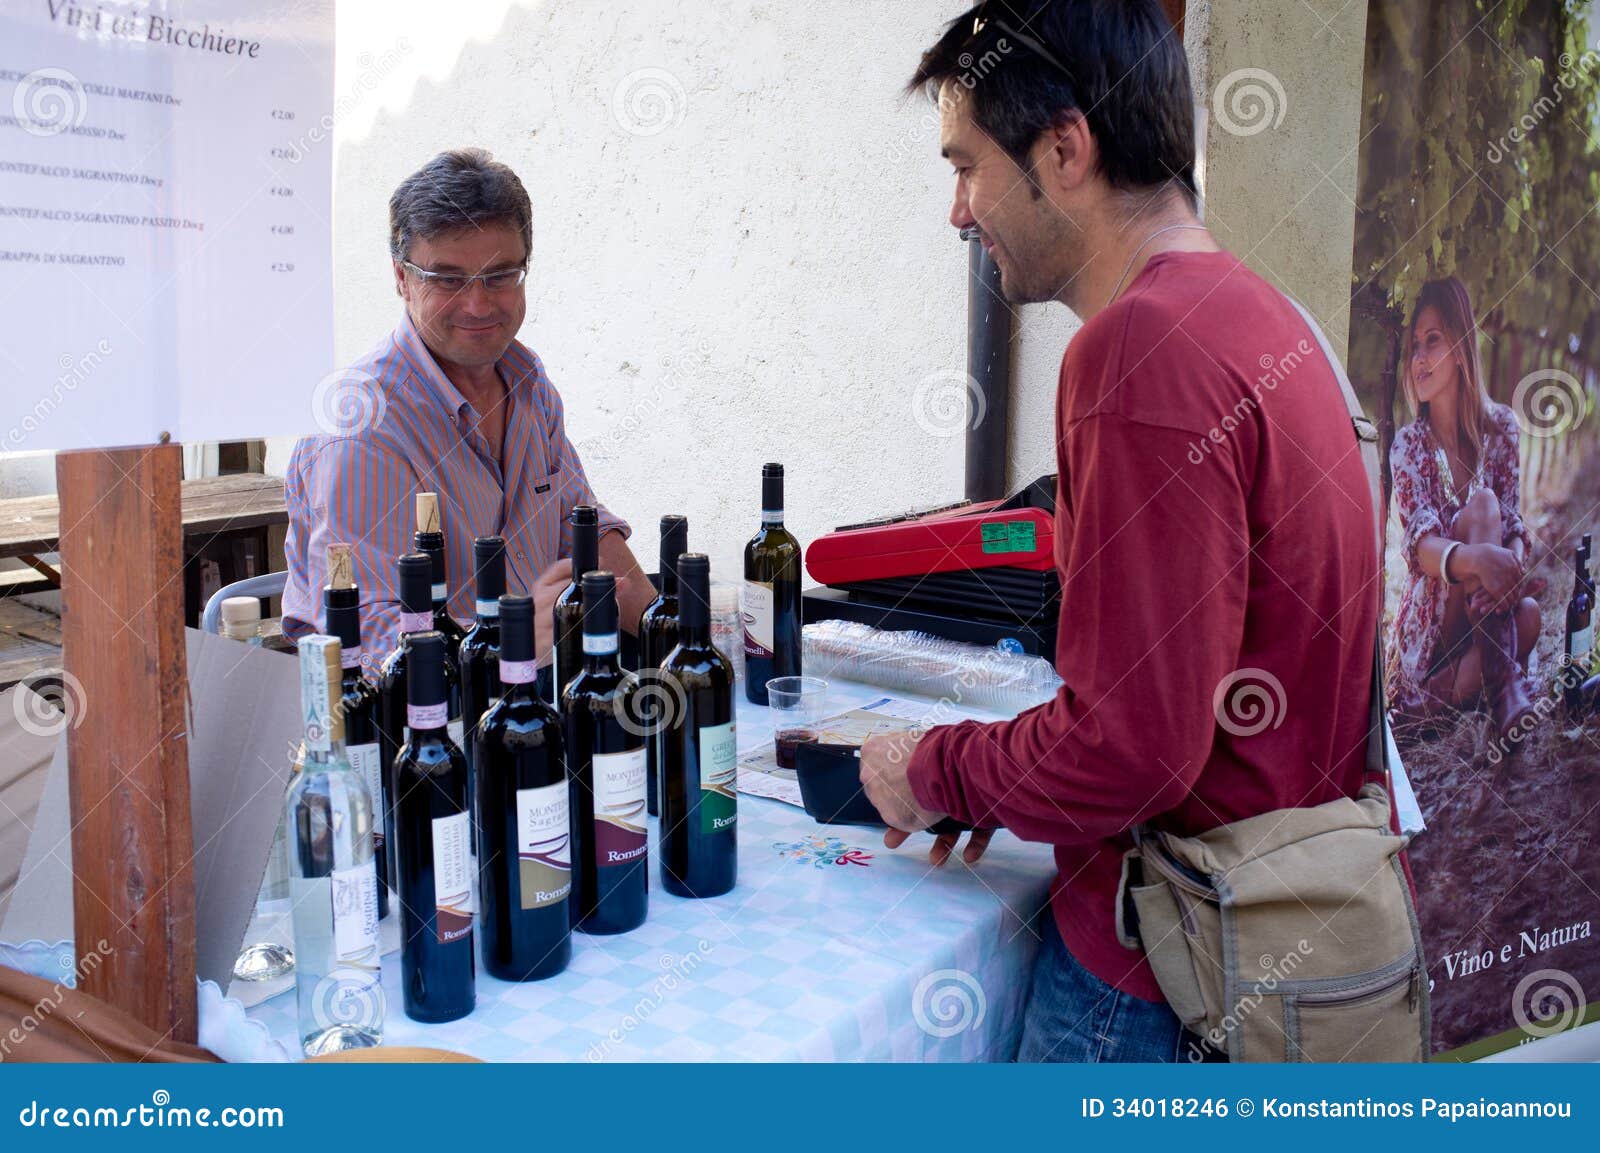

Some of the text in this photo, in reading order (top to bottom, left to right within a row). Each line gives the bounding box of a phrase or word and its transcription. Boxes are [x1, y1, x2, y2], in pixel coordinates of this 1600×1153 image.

[148, 15, 261, 58] Bicchiere
[0, 161, 71, 178] ONTEFALCO
[72, 168, 139, 184] SAGRANTINO
[73, 212, 140, 226] SAGRANTINO
[59, 254, 126, 266] SAGRANTINO
[1443, 920, 1591, 981] Vino e Natura
